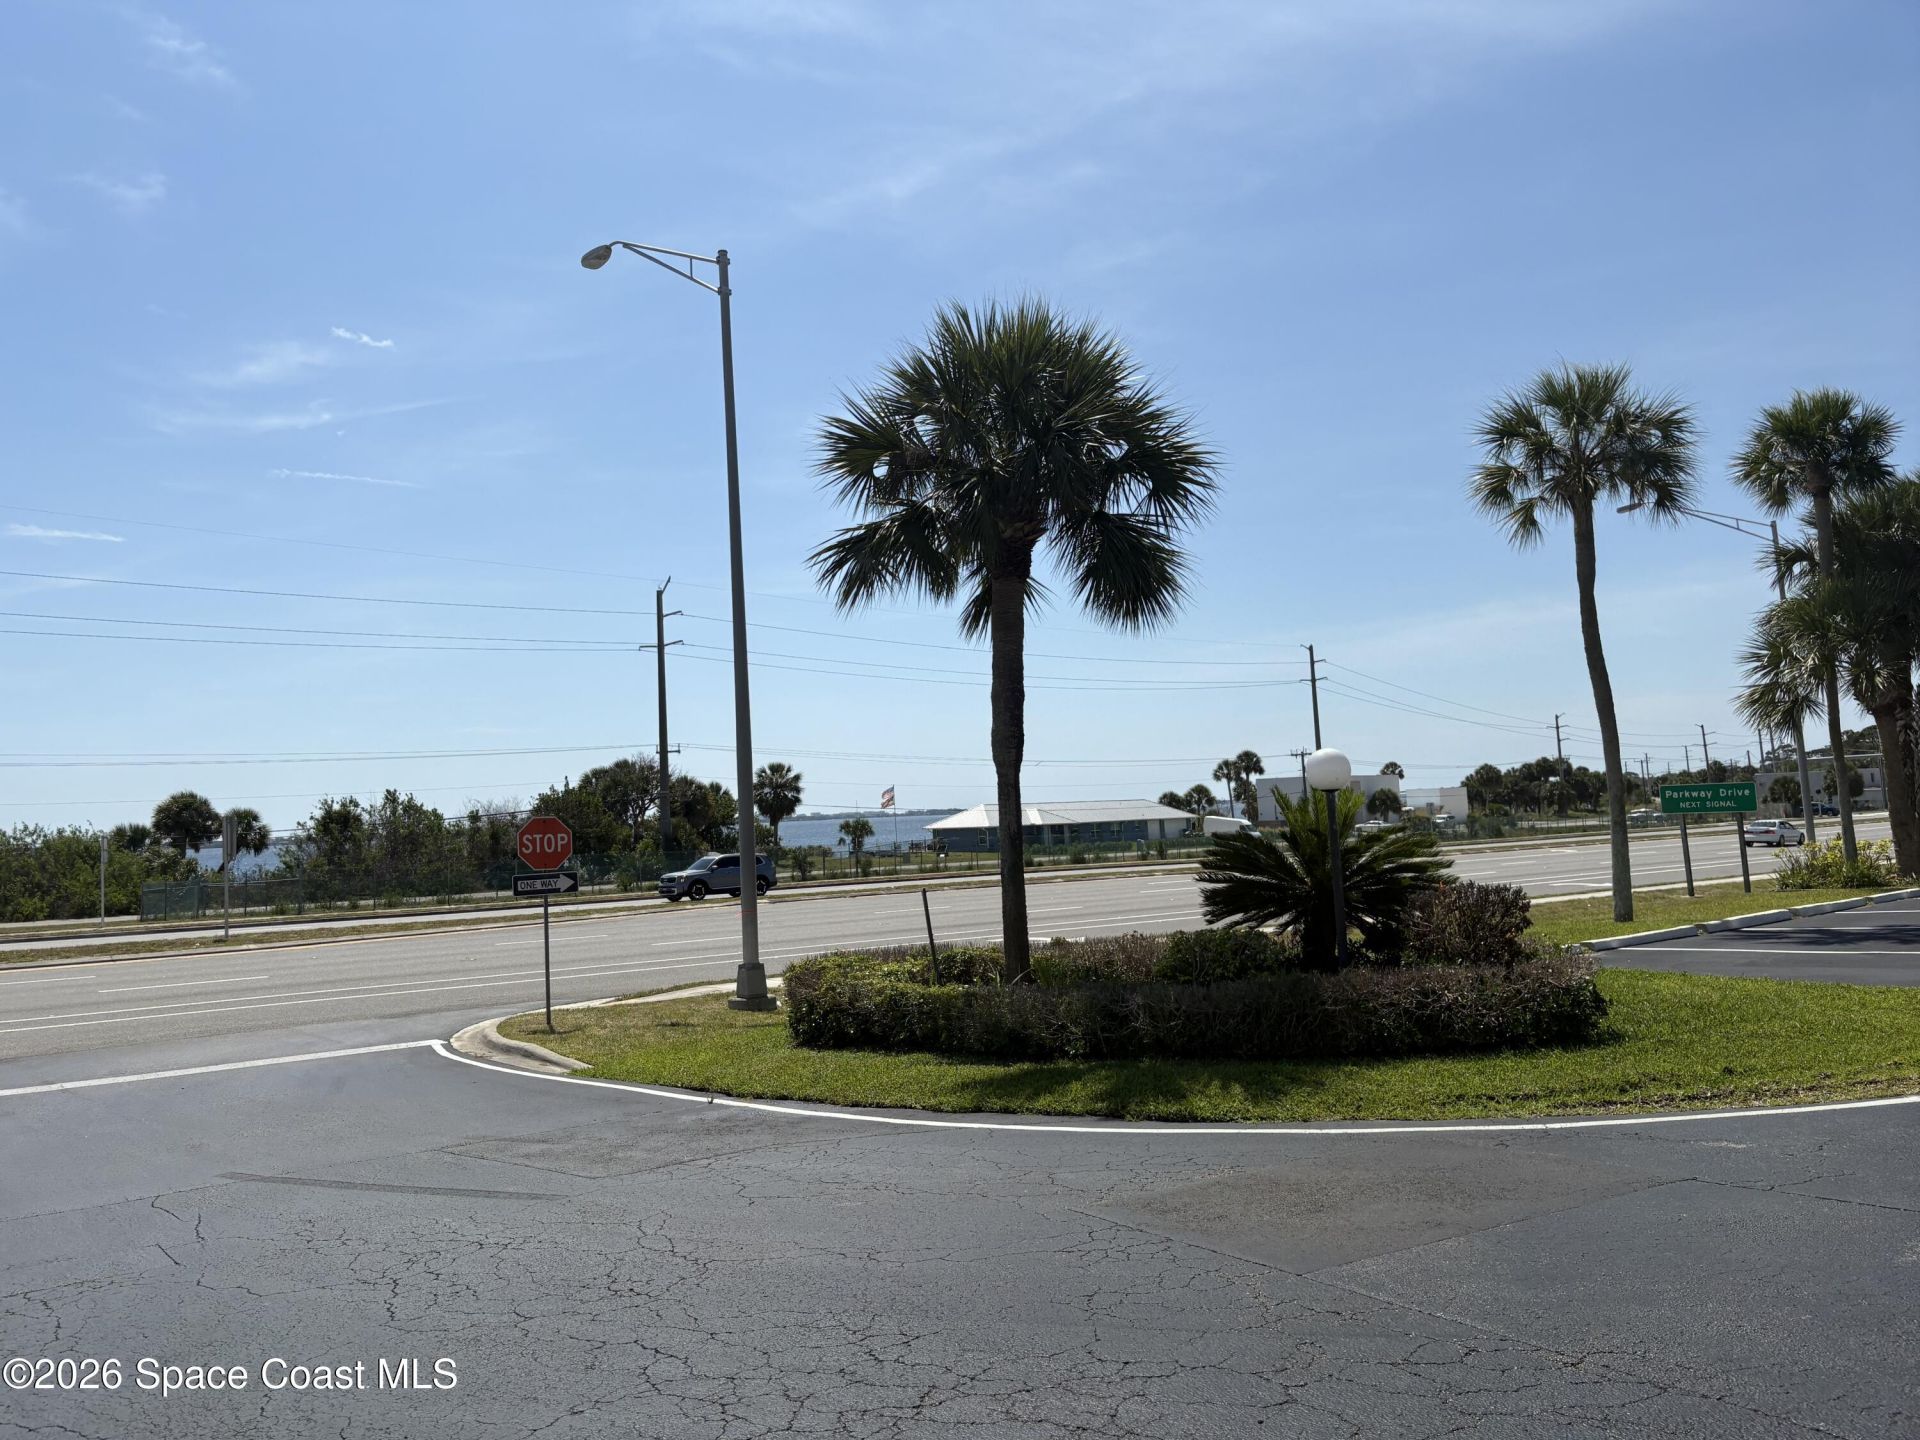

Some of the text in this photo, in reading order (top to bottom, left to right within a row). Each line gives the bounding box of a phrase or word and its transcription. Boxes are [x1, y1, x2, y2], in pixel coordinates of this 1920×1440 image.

[1665, 788, 1750, 799] Parkway Drive
[1706, 800, 1737, 808] SIGNAL
[521, 833, 568, 854] STOP
[520, 879, 559, 890] ONE WAY
